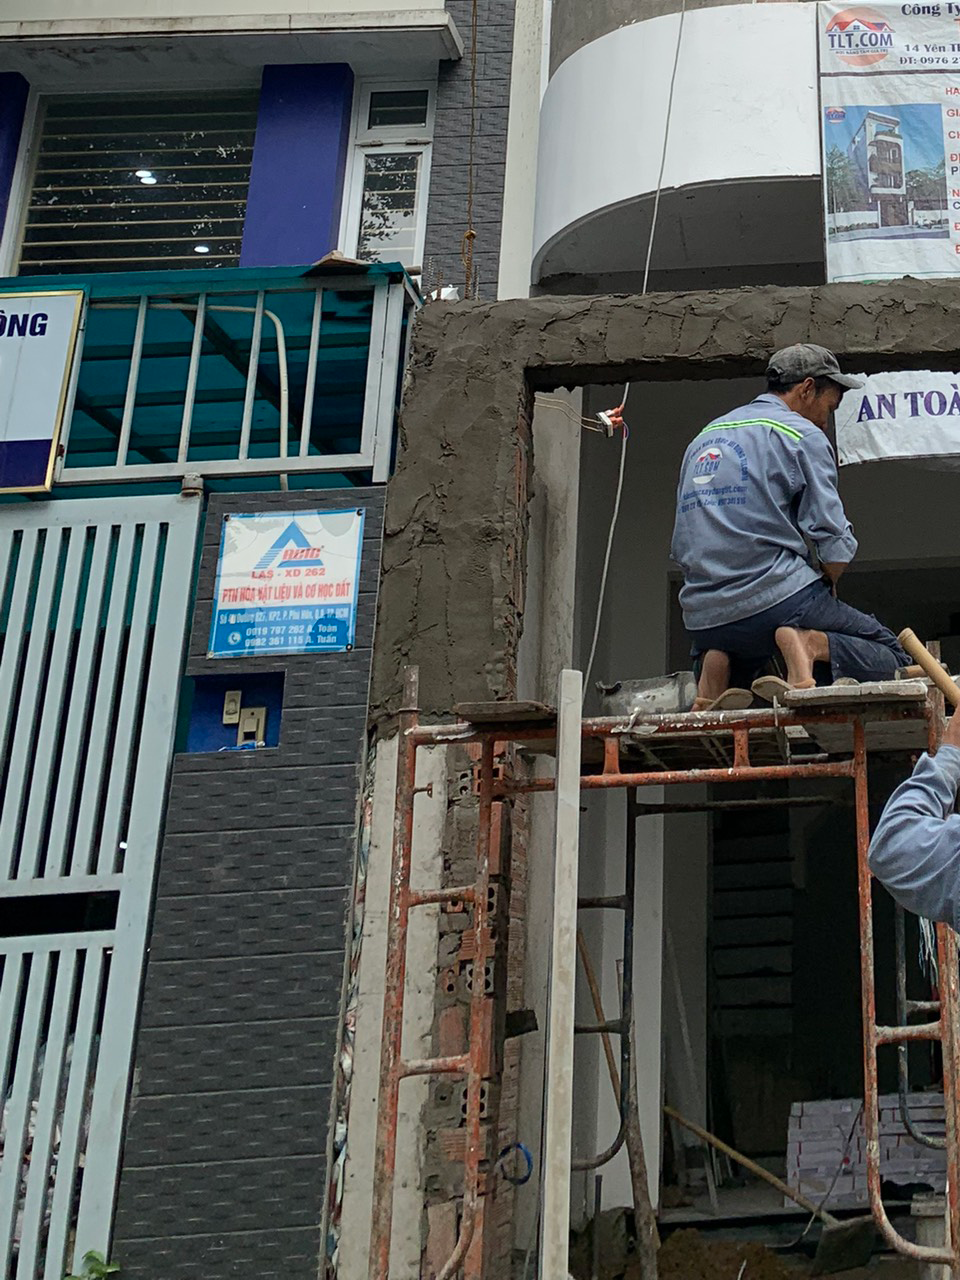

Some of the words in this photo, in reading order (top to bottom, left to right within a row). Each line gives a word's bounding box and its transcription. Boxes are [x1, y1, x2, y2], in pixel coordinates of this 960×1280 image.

[901, 3, 941, 17] Công
[828, 32, 893, 48] TLT.COM
[904, 44, 919, 52] 14
[923, 43, 946, 52] Yên
[899, 56, 917, 64] ĐT:
[920, 56, 949, 64] 0976
[856, 393, 897, 422] AN
[304, 567, 326, 577] 262
